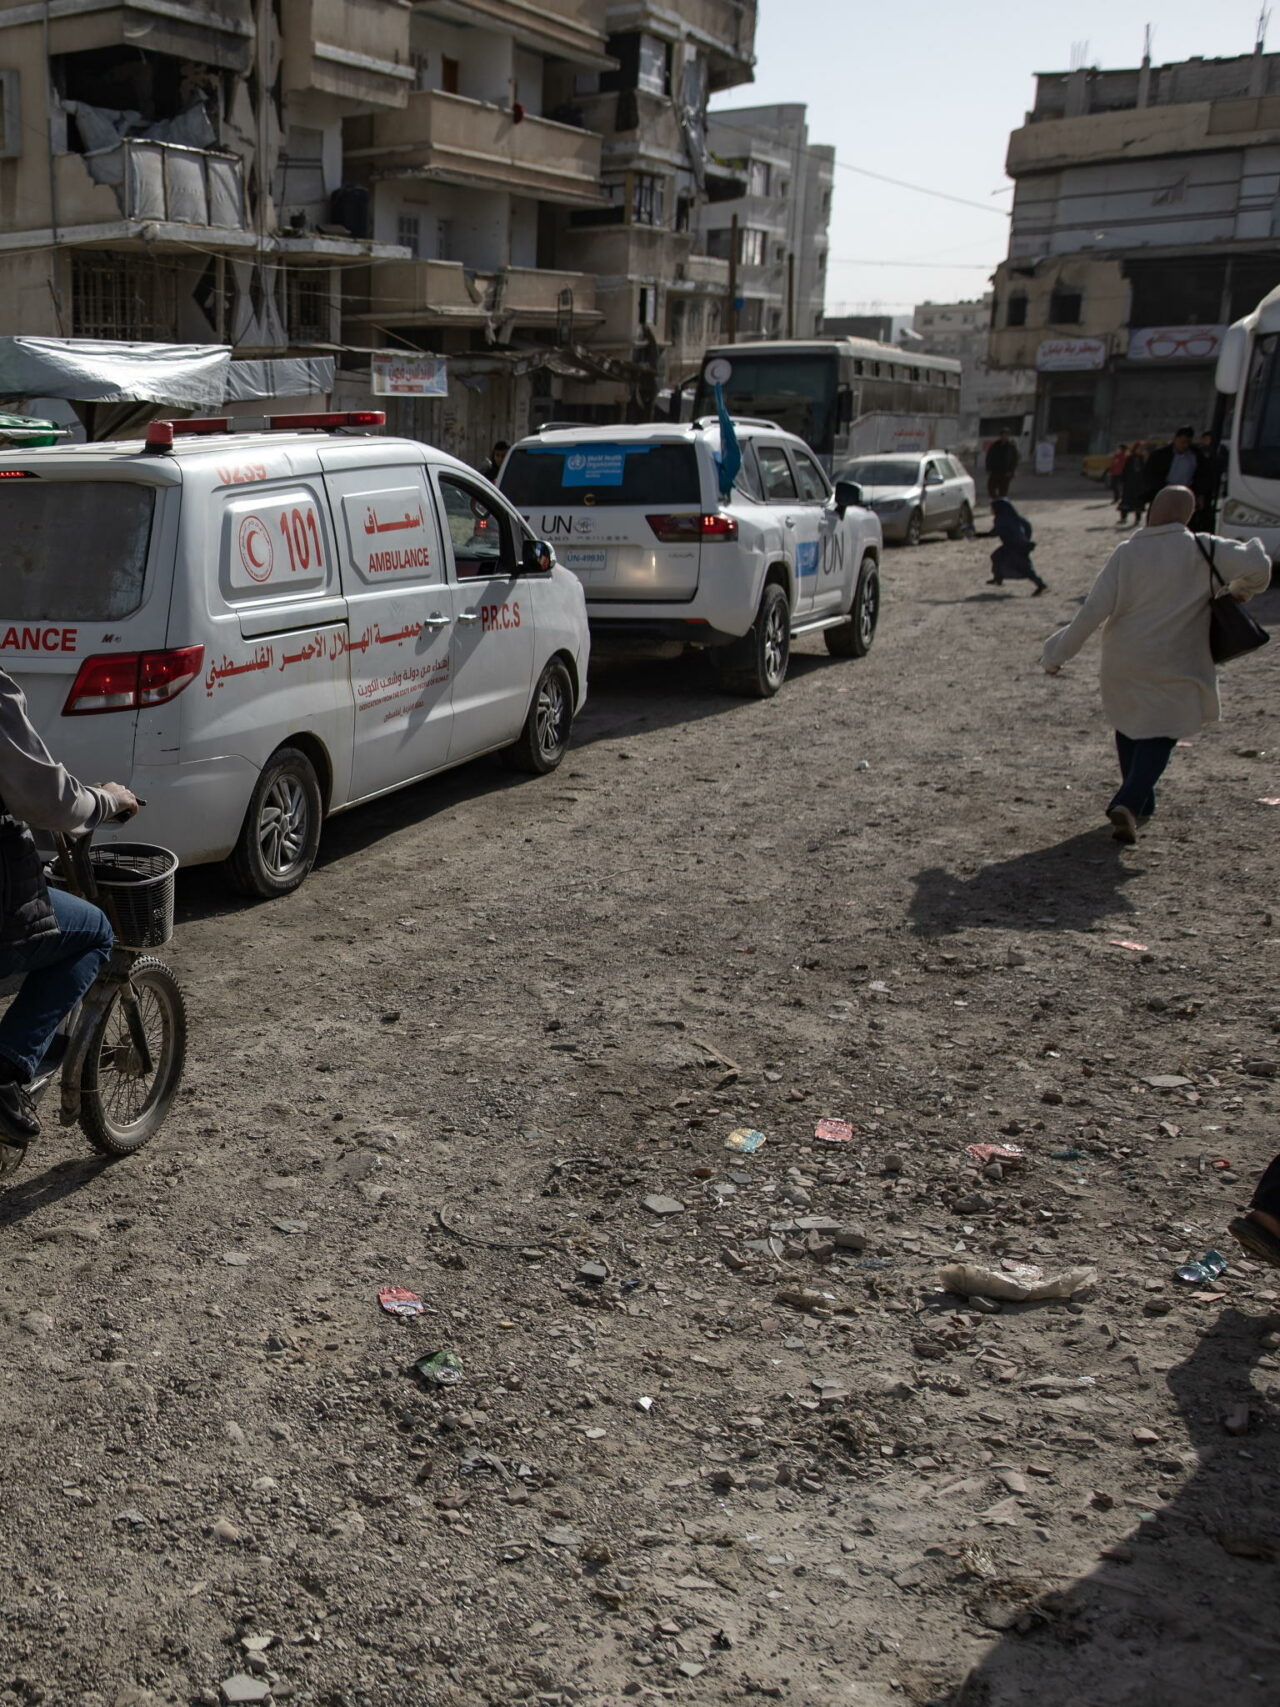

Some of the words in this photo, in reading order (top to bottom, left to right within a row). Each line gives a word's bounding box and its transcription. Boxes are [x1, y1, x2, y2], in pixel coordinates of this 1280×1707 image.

[280, 508, 322, 572] 101
[542, 515, 573, 534] UN
[369, 547, 429, 573] AMBULANCE
[823, 531, 844, 576] UN
[374, 621, 424, 647] جمعية
[481, 601, 521, 632] P.R.C.S
[278, 631, 326, 673] الأحمر
[329, 626, 372, 661] الهلال
[205, 644, 274, 697] الفلسطيني
